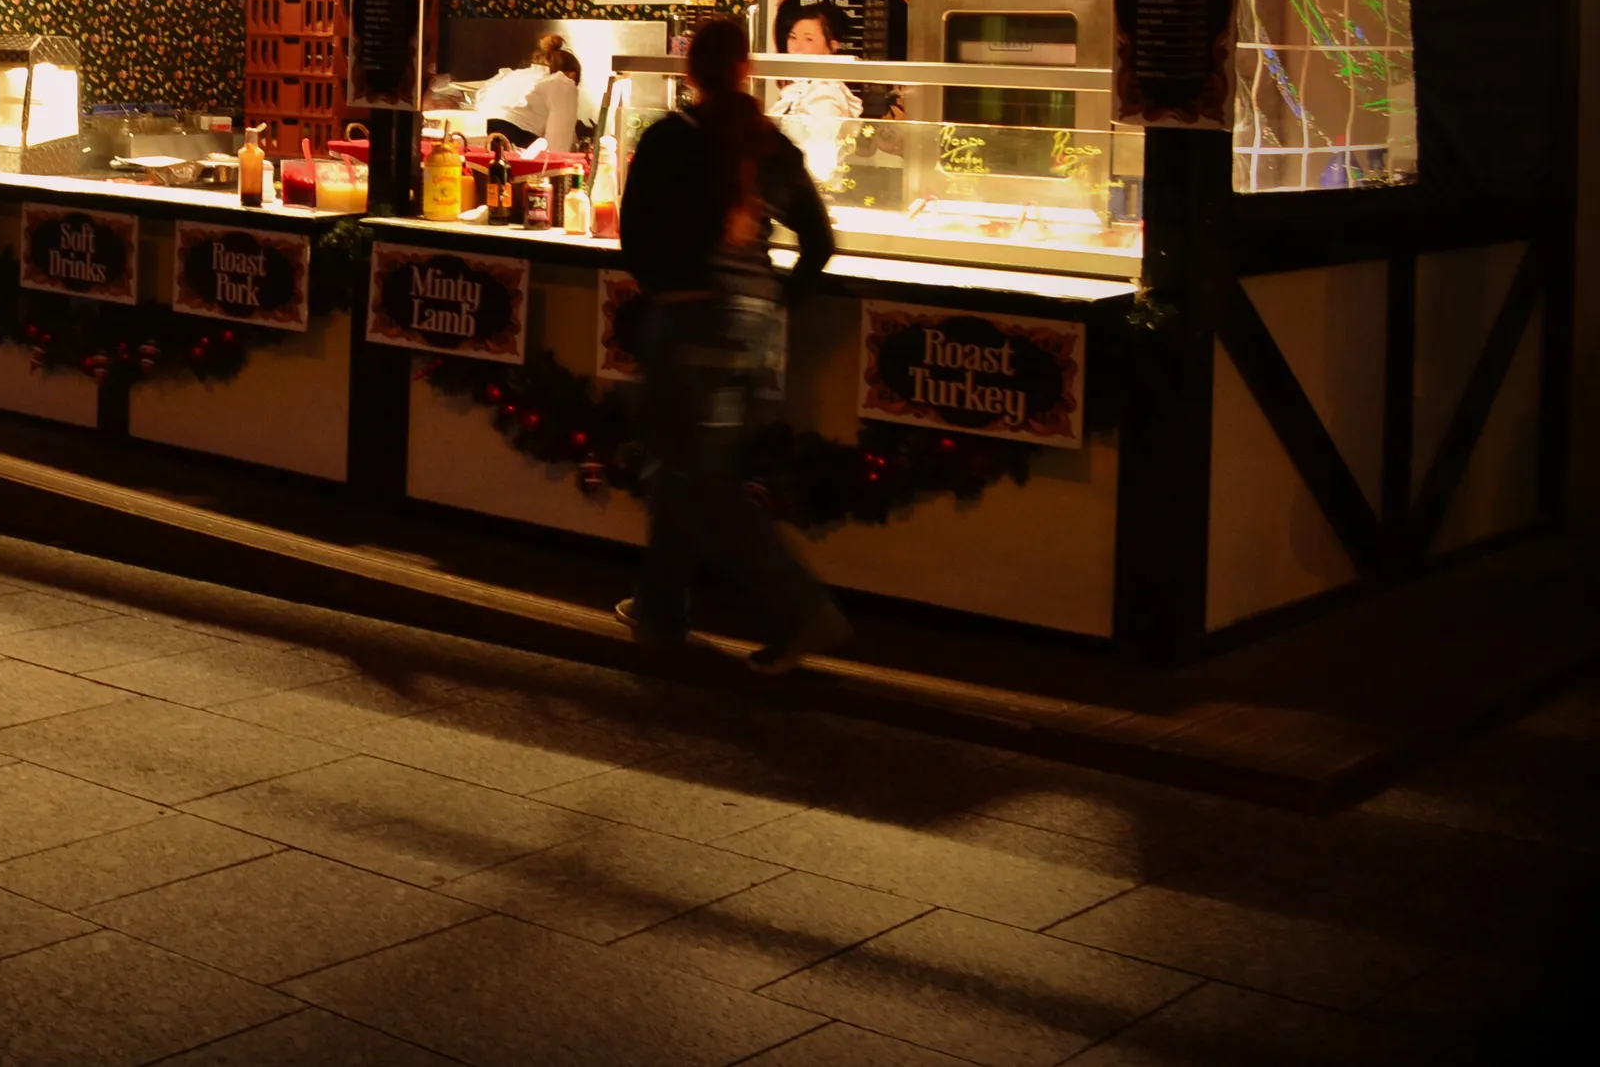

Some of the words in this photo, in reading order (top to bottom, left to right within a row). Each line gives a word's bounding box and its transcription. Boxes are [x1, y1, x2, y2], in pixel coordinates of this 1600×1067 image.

[59, 222, 98, 254] Soft
[47, 249, 107, 284] Drinks
[211, 241, 268, 279] Roast
[215, 271, 262, 307] Pork
[408, 264, 483, 314] Minty
[408, 298, 477, 338] Lamb
[921, 327, 1017, 377] Roast
[907, 365, 1028, 427] Turkey
